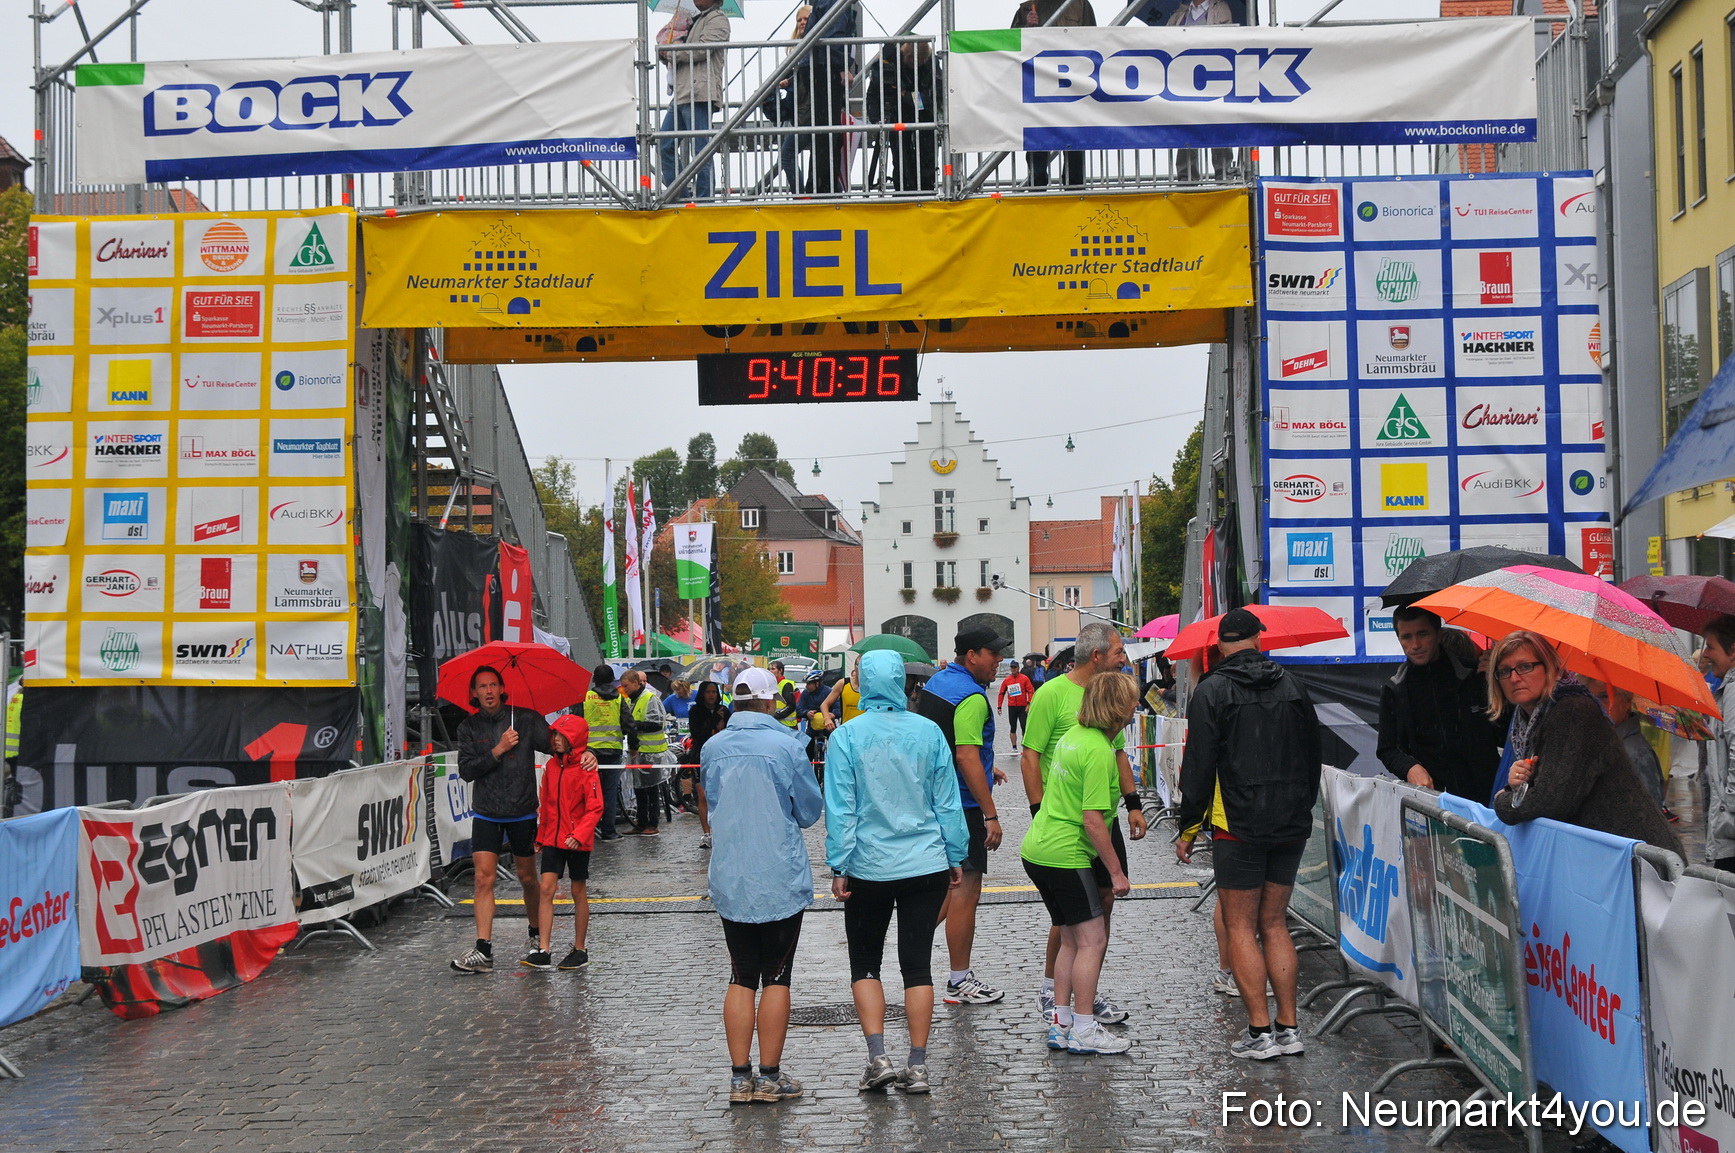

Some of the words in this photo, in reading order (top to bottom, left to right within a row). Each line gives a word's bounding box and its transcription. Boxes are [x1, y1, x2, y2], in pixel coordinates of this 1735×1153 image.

[1022, 48, 1312, 104] BOCK
[144, 70, 413, 137] BOCK
[1404, 123, 1526, 137] www.bockonline.de
[505, 143, 625, 158] www.bockonline.de
[1274, 192, 1292, 203] GUT
[1292, 192, 1311, 204] FÜR
[1312, 193, 1331, 204] SIE!
[1281, 213, 1307, 221] Sparkasse
[1382, 205, 1434, 217] Bionorica
[1488, 208, 1533, 216] ReiseCenter
[96, 237, 171, 263] Charivari
[200, 245, 250, 253] WITTMANN
[704, 229, 903, 300] ZIEL
[1012, 259, 1118, 277] Neumarkter
[1121, 254, 1205, 274] Stadtlauf
[1378, 256, 1415, 281] RUND
[406, 274, 509, 290] Neumarkter
[513, 273, 594, 290] Stadtlauf
[1268, 273, 1316, 289] swn
[1480, 280, 1511, 294] Braun
[1377, 280, 1421, 301] SCHAU
[193, 296, 214, 306] GUT
[214, 294, 233, 306] FÜR
[234, 295, 254, 306] SIE!
[1473, 330, 1535, 341] INTERSPORT
[1463, 341, 1535, 354] HACKNER
[1293, 357, 1315, 371] DEHN
[1375, 353, 1428, 363] Neumarkter
[1366, 362, 1436, 375] Lammsbräu
[298, 373, 342, 386] Bionorica
[748, 356, 900, 399] 9:40:36
[111, 390, 149, 401] KANN
[1461, 404, 1541, 429] Charivari
[1291, 422, 1315, 430] MAX
[1319, 420, 1347, 429] BÖGL
[104, 434, 163, 443] INTERSPORT
[94, 444, 162, 456] HACKNER
[276, 442, 315, 451] Neumarkter
[315, 441, 339, 451] Tagblatt
[231, 449, 256, 457] BÖGL
[1273, 481, 1315, 489] GERHART
[1290, 488, 1321, 496] JANIG
[108, 497, 144, 517] maxi
[1385, 495, 1425, 507] KANN
[127, 525, 143, 537] dsl
[206, 522, 228, 535] DEHN
[1292, 537, 1329, 557] maxi
[1386, 533, 1423, 557] RUND
[1313, 567, 1329, 579] dsl
[106, 583, 136, 591] JANIG
[199, 585, 229, 600] Braun
[284, 587, 333, 596] Neumarkter
[274, 595, 341, 608] Lammsbräu
[102, 627, 139, 651] RUND
[175, 643, 228, 658] swn
[270, 643, 343, 660] NATHUS
[101, 650, 143, 671] SCHAU
[357, 795, 405, 862] swn
[137, 806, 277, 897] Egner
